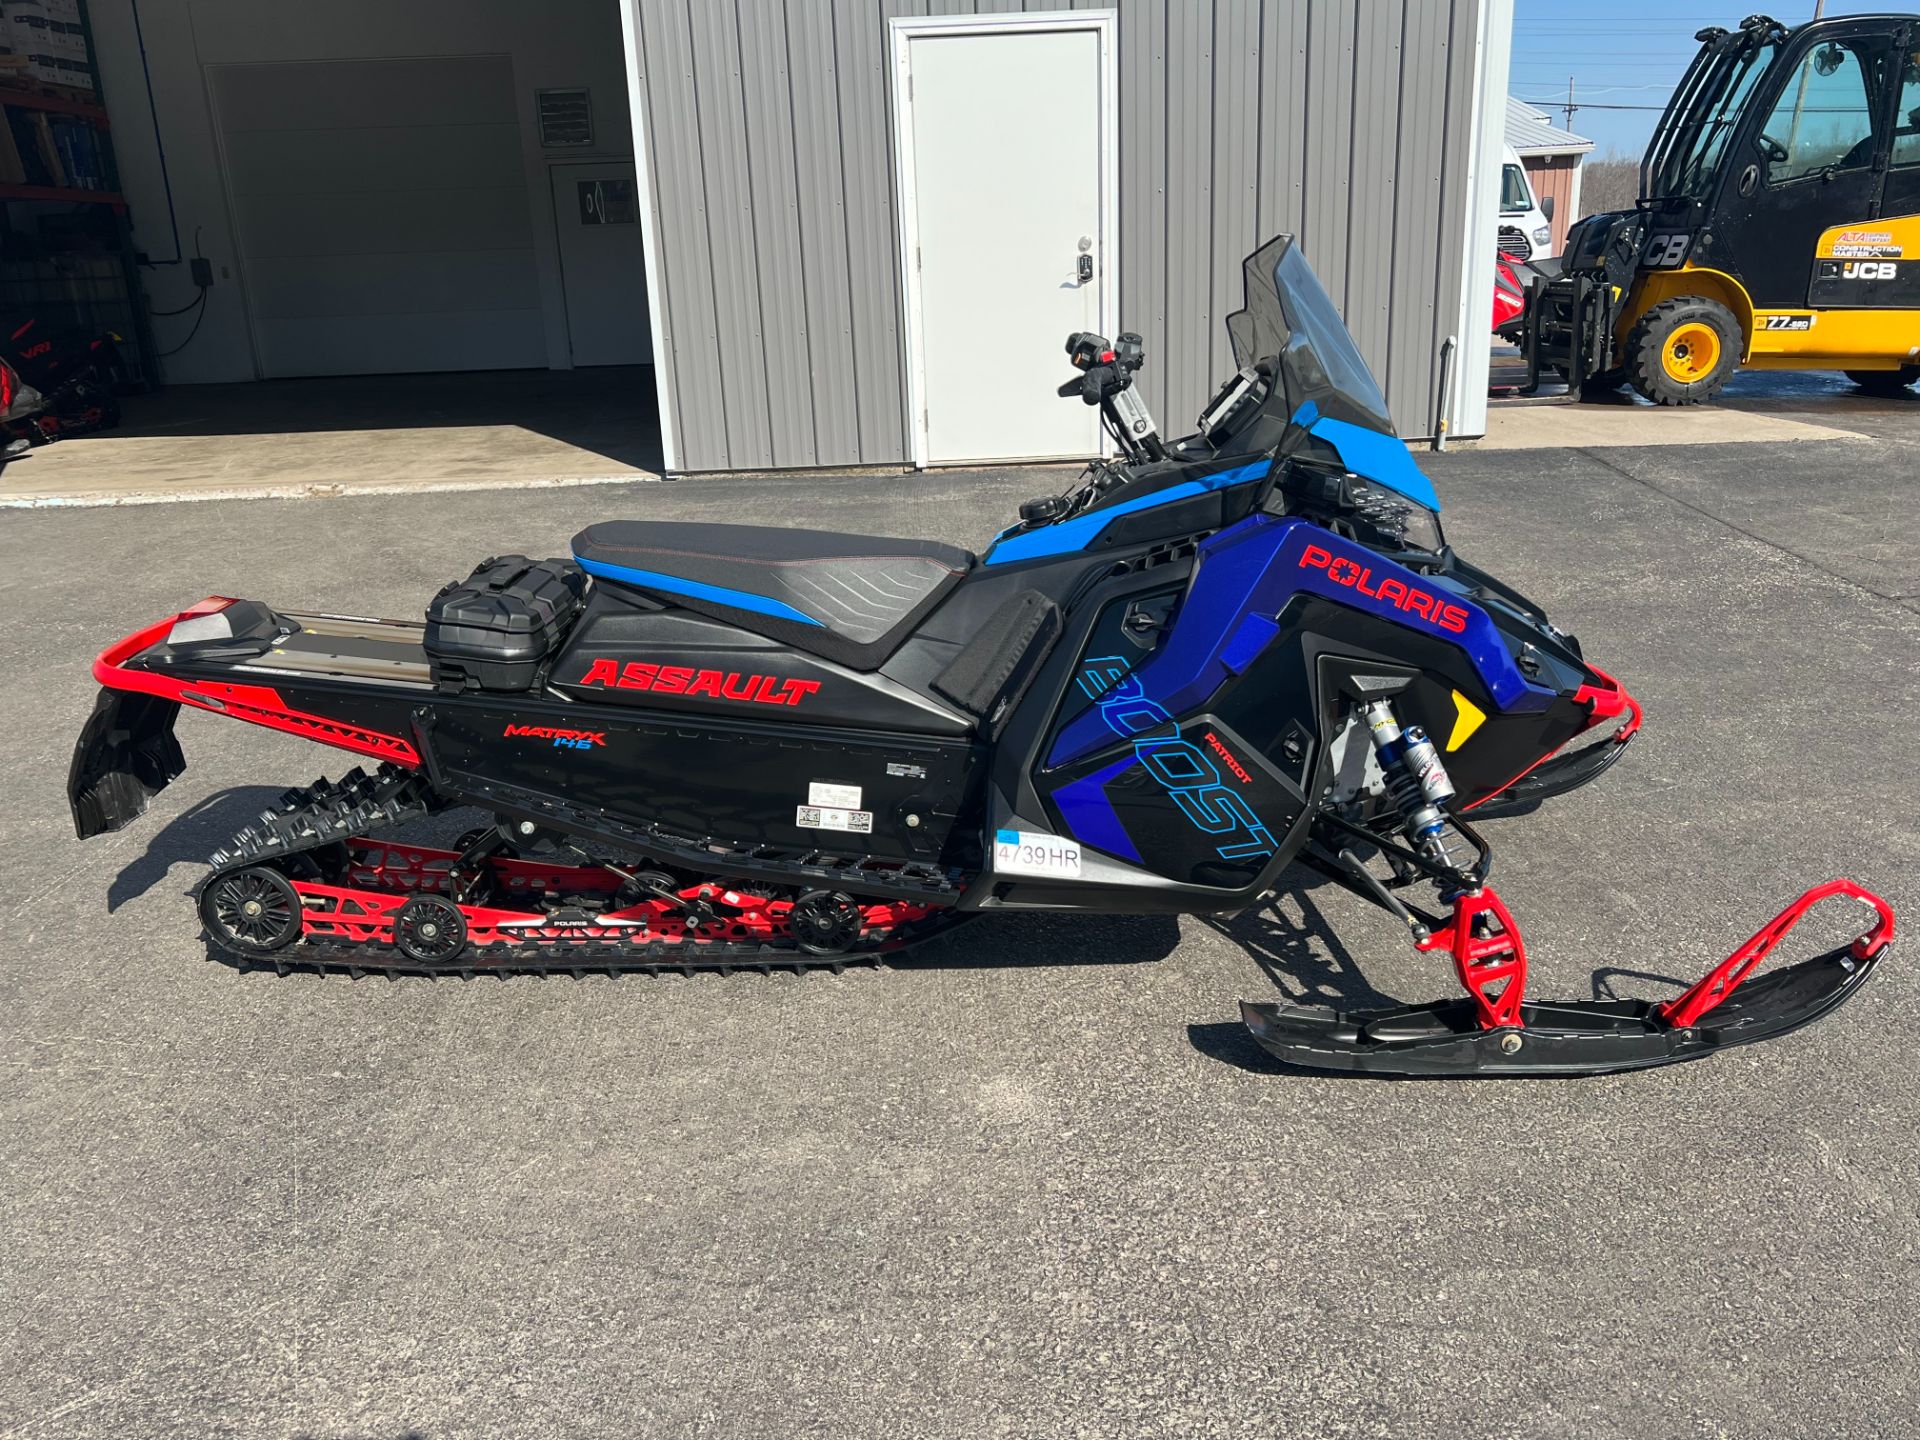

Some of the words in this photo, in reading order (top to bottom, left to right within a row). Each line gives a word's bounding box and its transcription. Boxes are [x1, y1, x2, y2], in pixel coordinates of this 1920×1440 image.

[1837, 232, 1866, 242] ALTA
[1843, 262, 1897, 279] JCB
[1299, 544, 1470, 633] POLARIS
[580, 658, 822, 706] ASSAULT
[504, 723, 606, 746] MATRYX
[553, 737, 592, 750] 146
[1076, 655, 1280, 860] BOOST
[1204, 732, 1253, 784] PATRIOT
